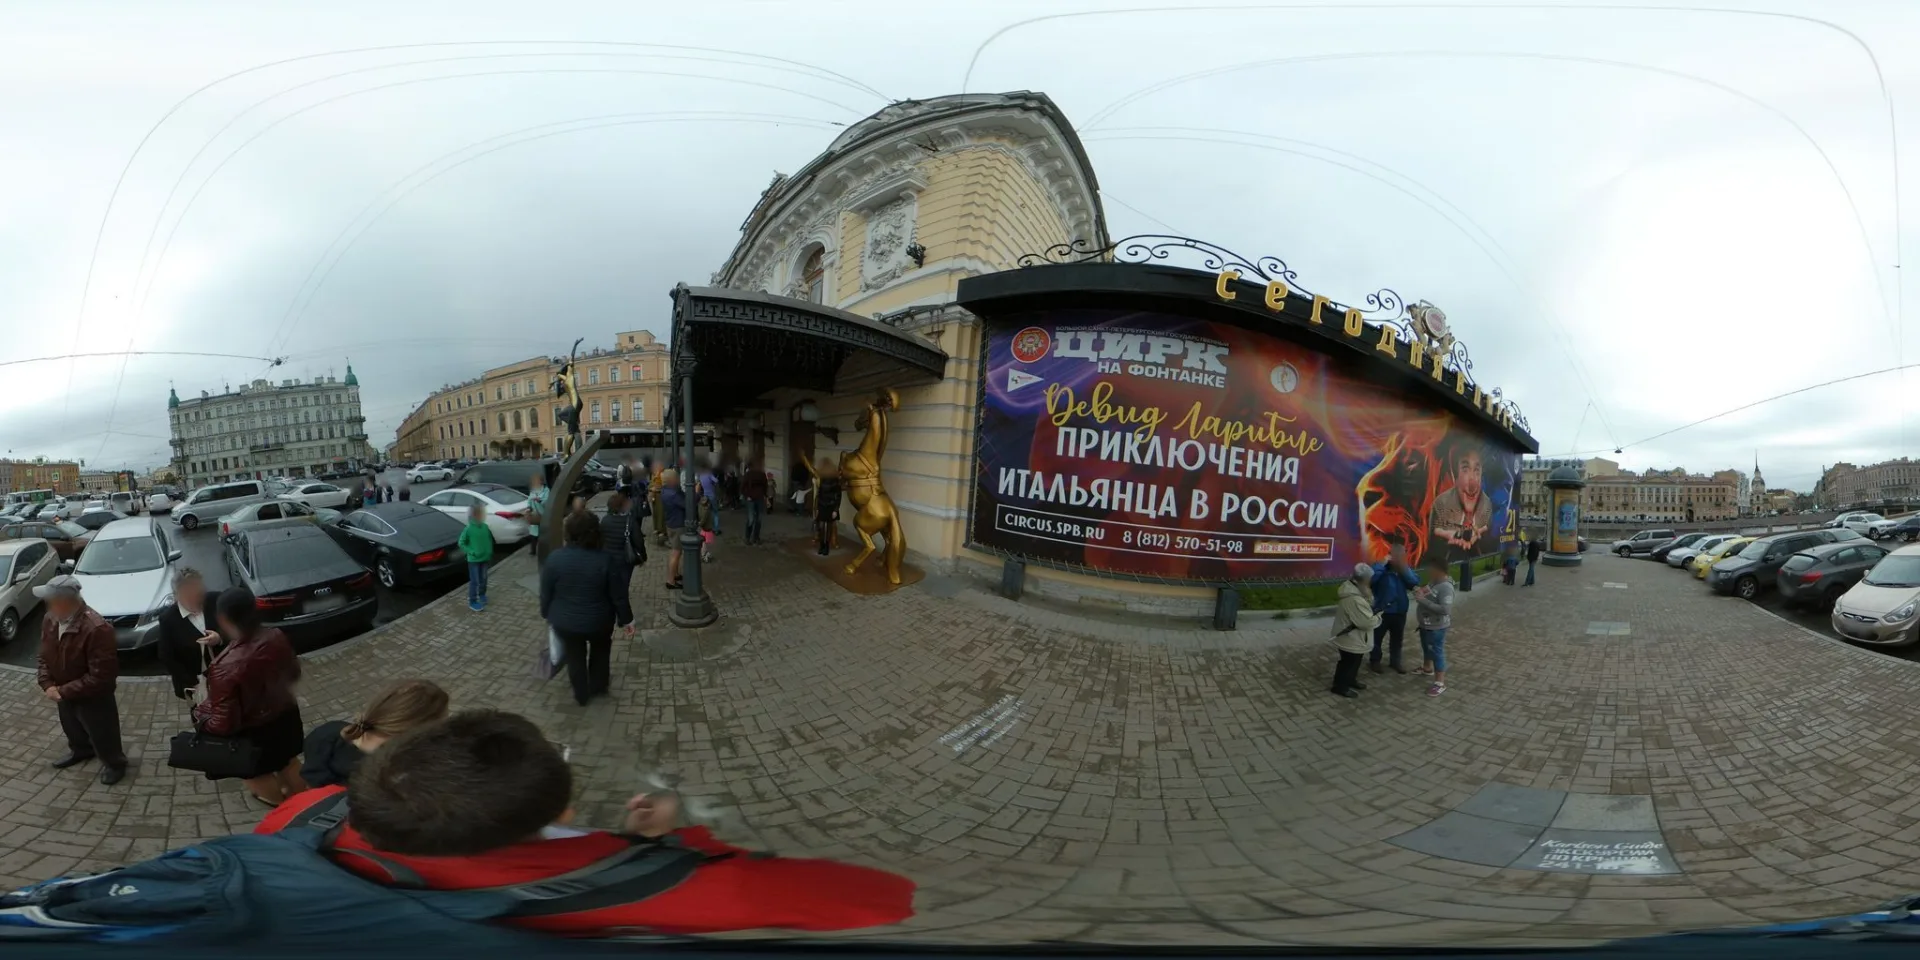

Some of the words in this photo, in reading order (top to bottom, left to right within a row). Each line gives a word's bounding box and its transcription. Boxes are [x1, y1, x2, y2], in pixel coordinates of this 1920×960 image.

[1053, 330, 1229, 375] ЦИРК
[1097, 361, 1122, 375] НА
[1128, 364, 1226, 389] ФОНТАНКЕ
[1043, 381, 1169, 443] Девид
[1173, 401, 1324, 457] Ларибле
[1056, 426, 1300, 485] ПРИКЛЮЧЕНИЯ
[998, 466, 1178, 519] ИТАЛЬЯНЦА
[1190, 489, 1209, 519] В
[1220, 492, 1340, 529] РОССИИ
[1004, 513, 1106, 541] CIRCUS.SPB.RU
[1505, 508, 1516, 533] 21
[1123, 531, 1132, 544] 8
[1136, 530, 1171, 550] (812)
[1174, 535, 1244, 554] 570-51-98
